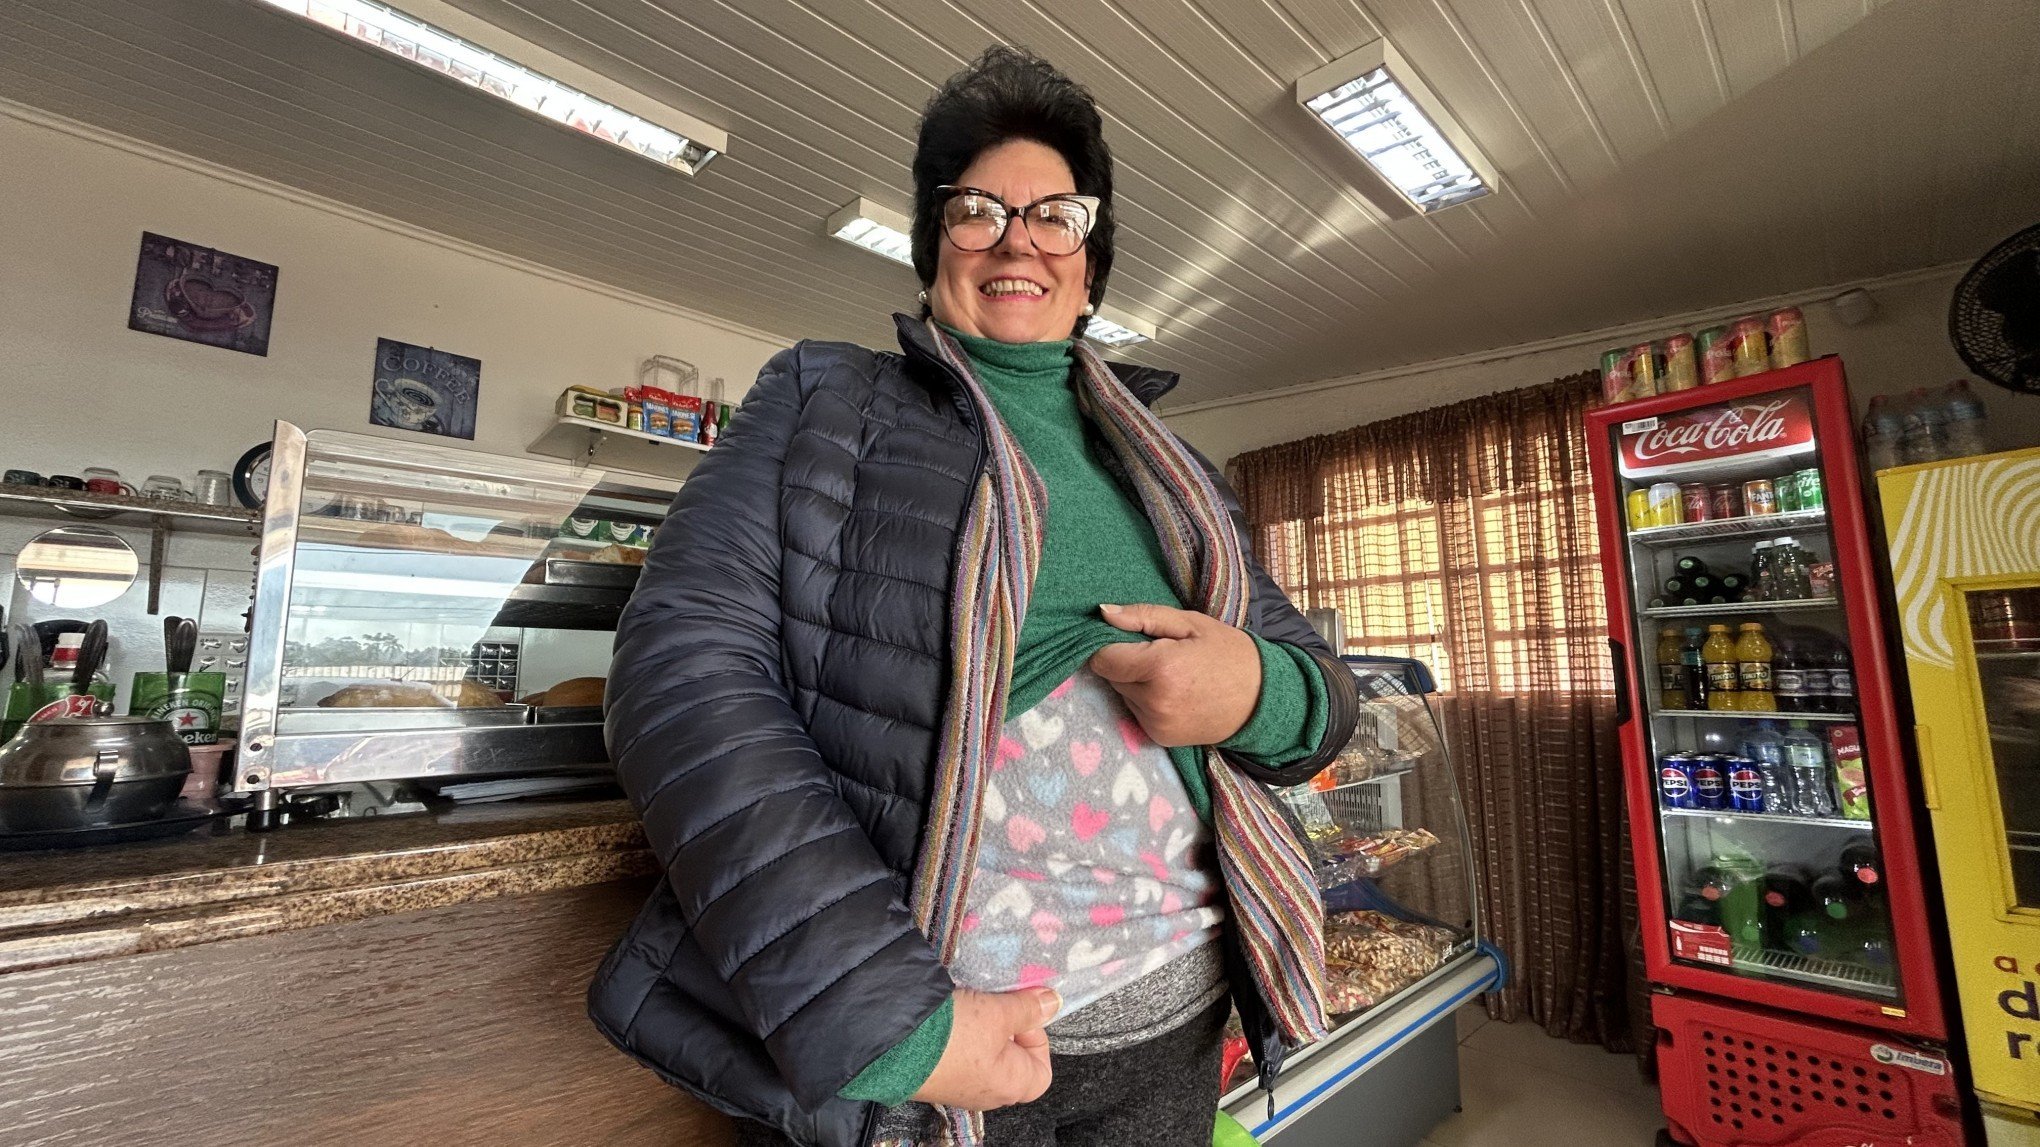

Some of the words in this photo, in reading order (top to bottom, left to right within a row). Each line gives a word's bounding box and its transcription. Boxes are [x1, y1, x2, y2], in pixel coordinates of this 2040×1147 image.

[382, 356, 470, 404] COFFEE
[1634, 398, 1792, 460] Coca-Cola
[1750, 491, 1774, 503] FANT
[1836, 744, 1860, 756] MAGU
[1732, 781, 1761, 789] PEPS
